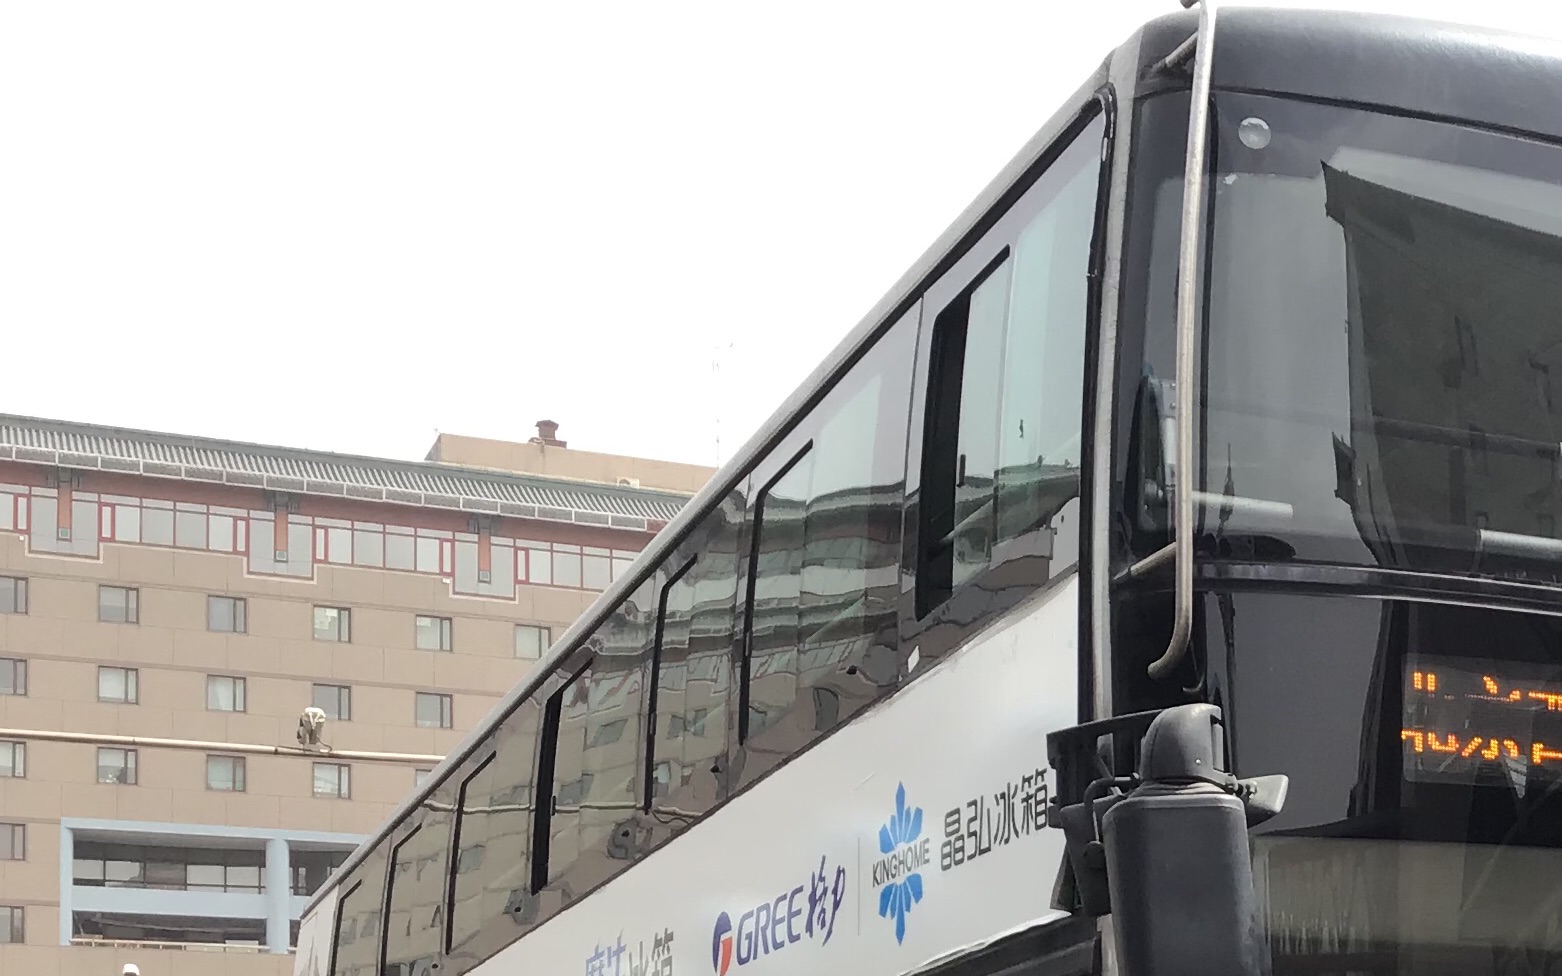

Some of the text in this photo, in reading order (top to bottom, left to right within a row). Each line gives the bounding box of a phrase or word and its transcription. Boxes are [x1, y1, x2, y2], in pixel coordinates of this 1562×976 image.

[940, 767, 1048, 872] 晶弘冰箱
[871, 836, 931, 889] KINGHOME
[735, 884, 804, 967] GREE
